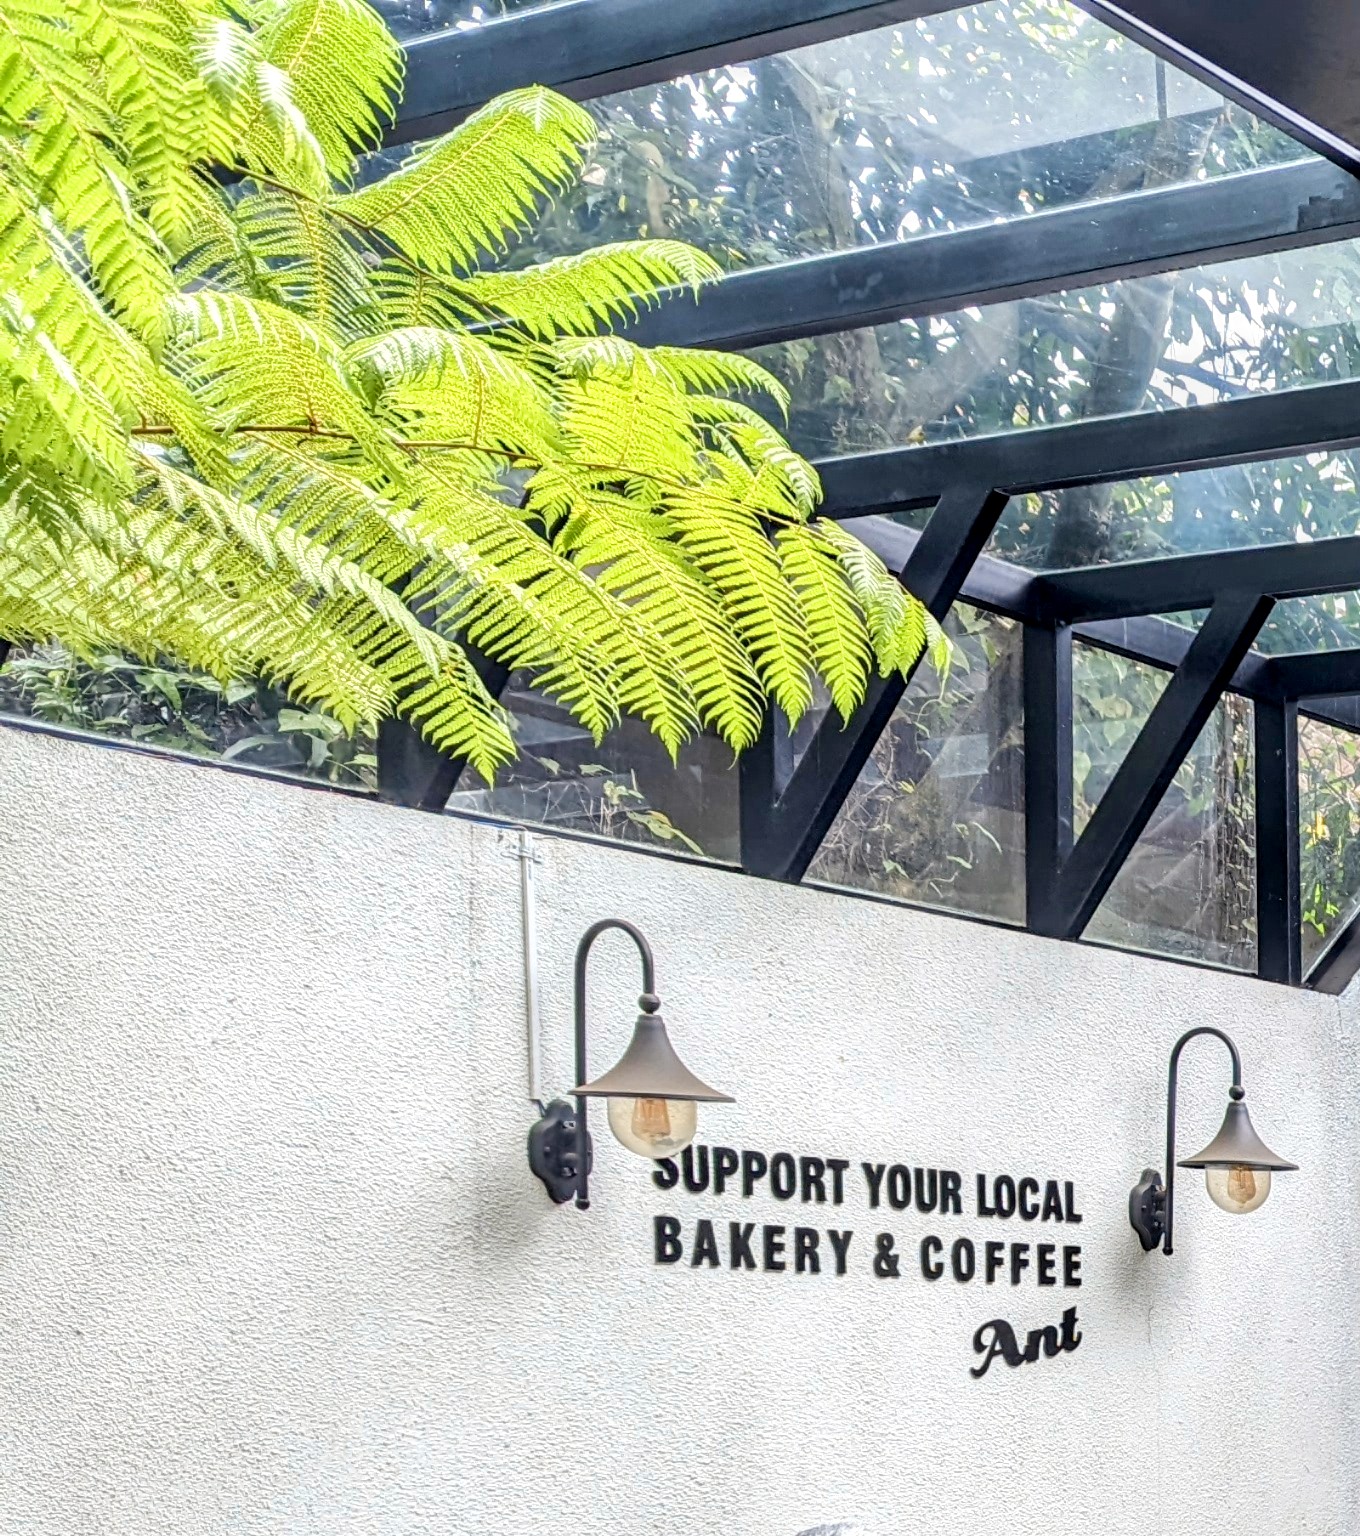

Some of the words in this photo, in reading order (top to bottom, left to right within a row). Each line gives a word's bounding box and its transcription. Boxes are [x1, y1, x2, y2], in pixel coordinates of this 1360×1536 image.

[652, 1143, 850, 1204] SUPPORT
[862, 1162, 964, 1215] YOUR
[977, 1173, 1083, 1223] LOCAL
[653, 1215, 853, 1276] BAKERY
[873, 1232, 900, 1278] &
[920, 1235, 1082, 1287] COFFEE
[969, 1306, 1083, 1379] Ant
